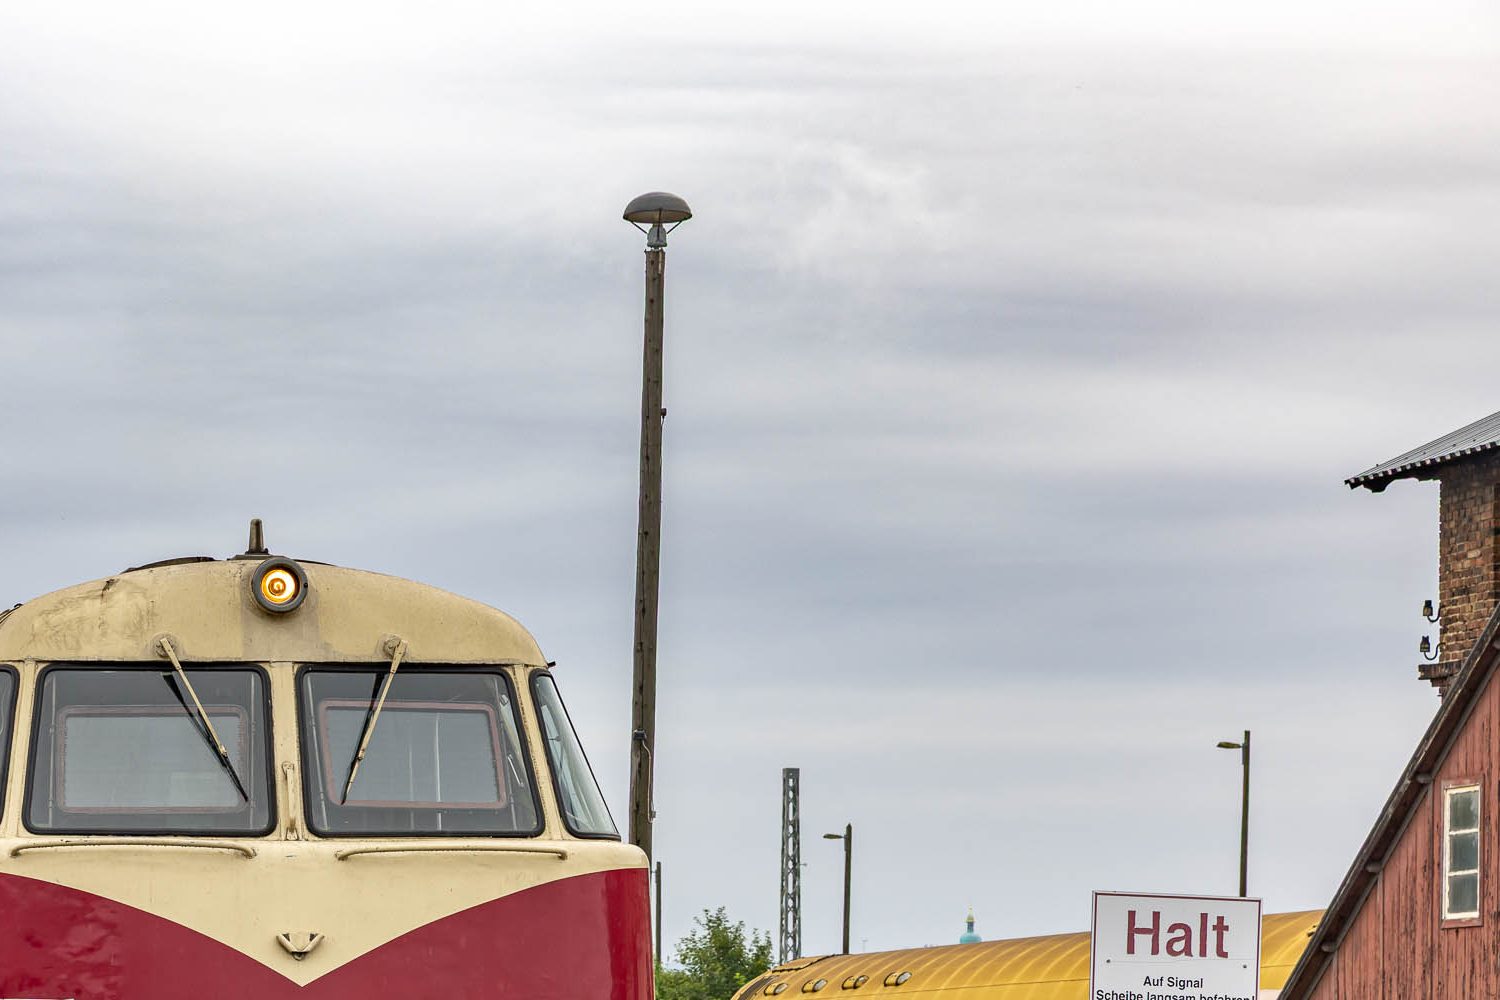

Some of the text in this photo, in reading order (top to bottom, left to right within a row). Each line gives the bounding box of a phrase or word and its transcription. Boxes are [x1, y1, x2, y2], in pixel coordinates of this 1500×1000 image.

[1126, 910, 1229, 958] Halt
[1143, 975, 1204, 990] Auf Signal
